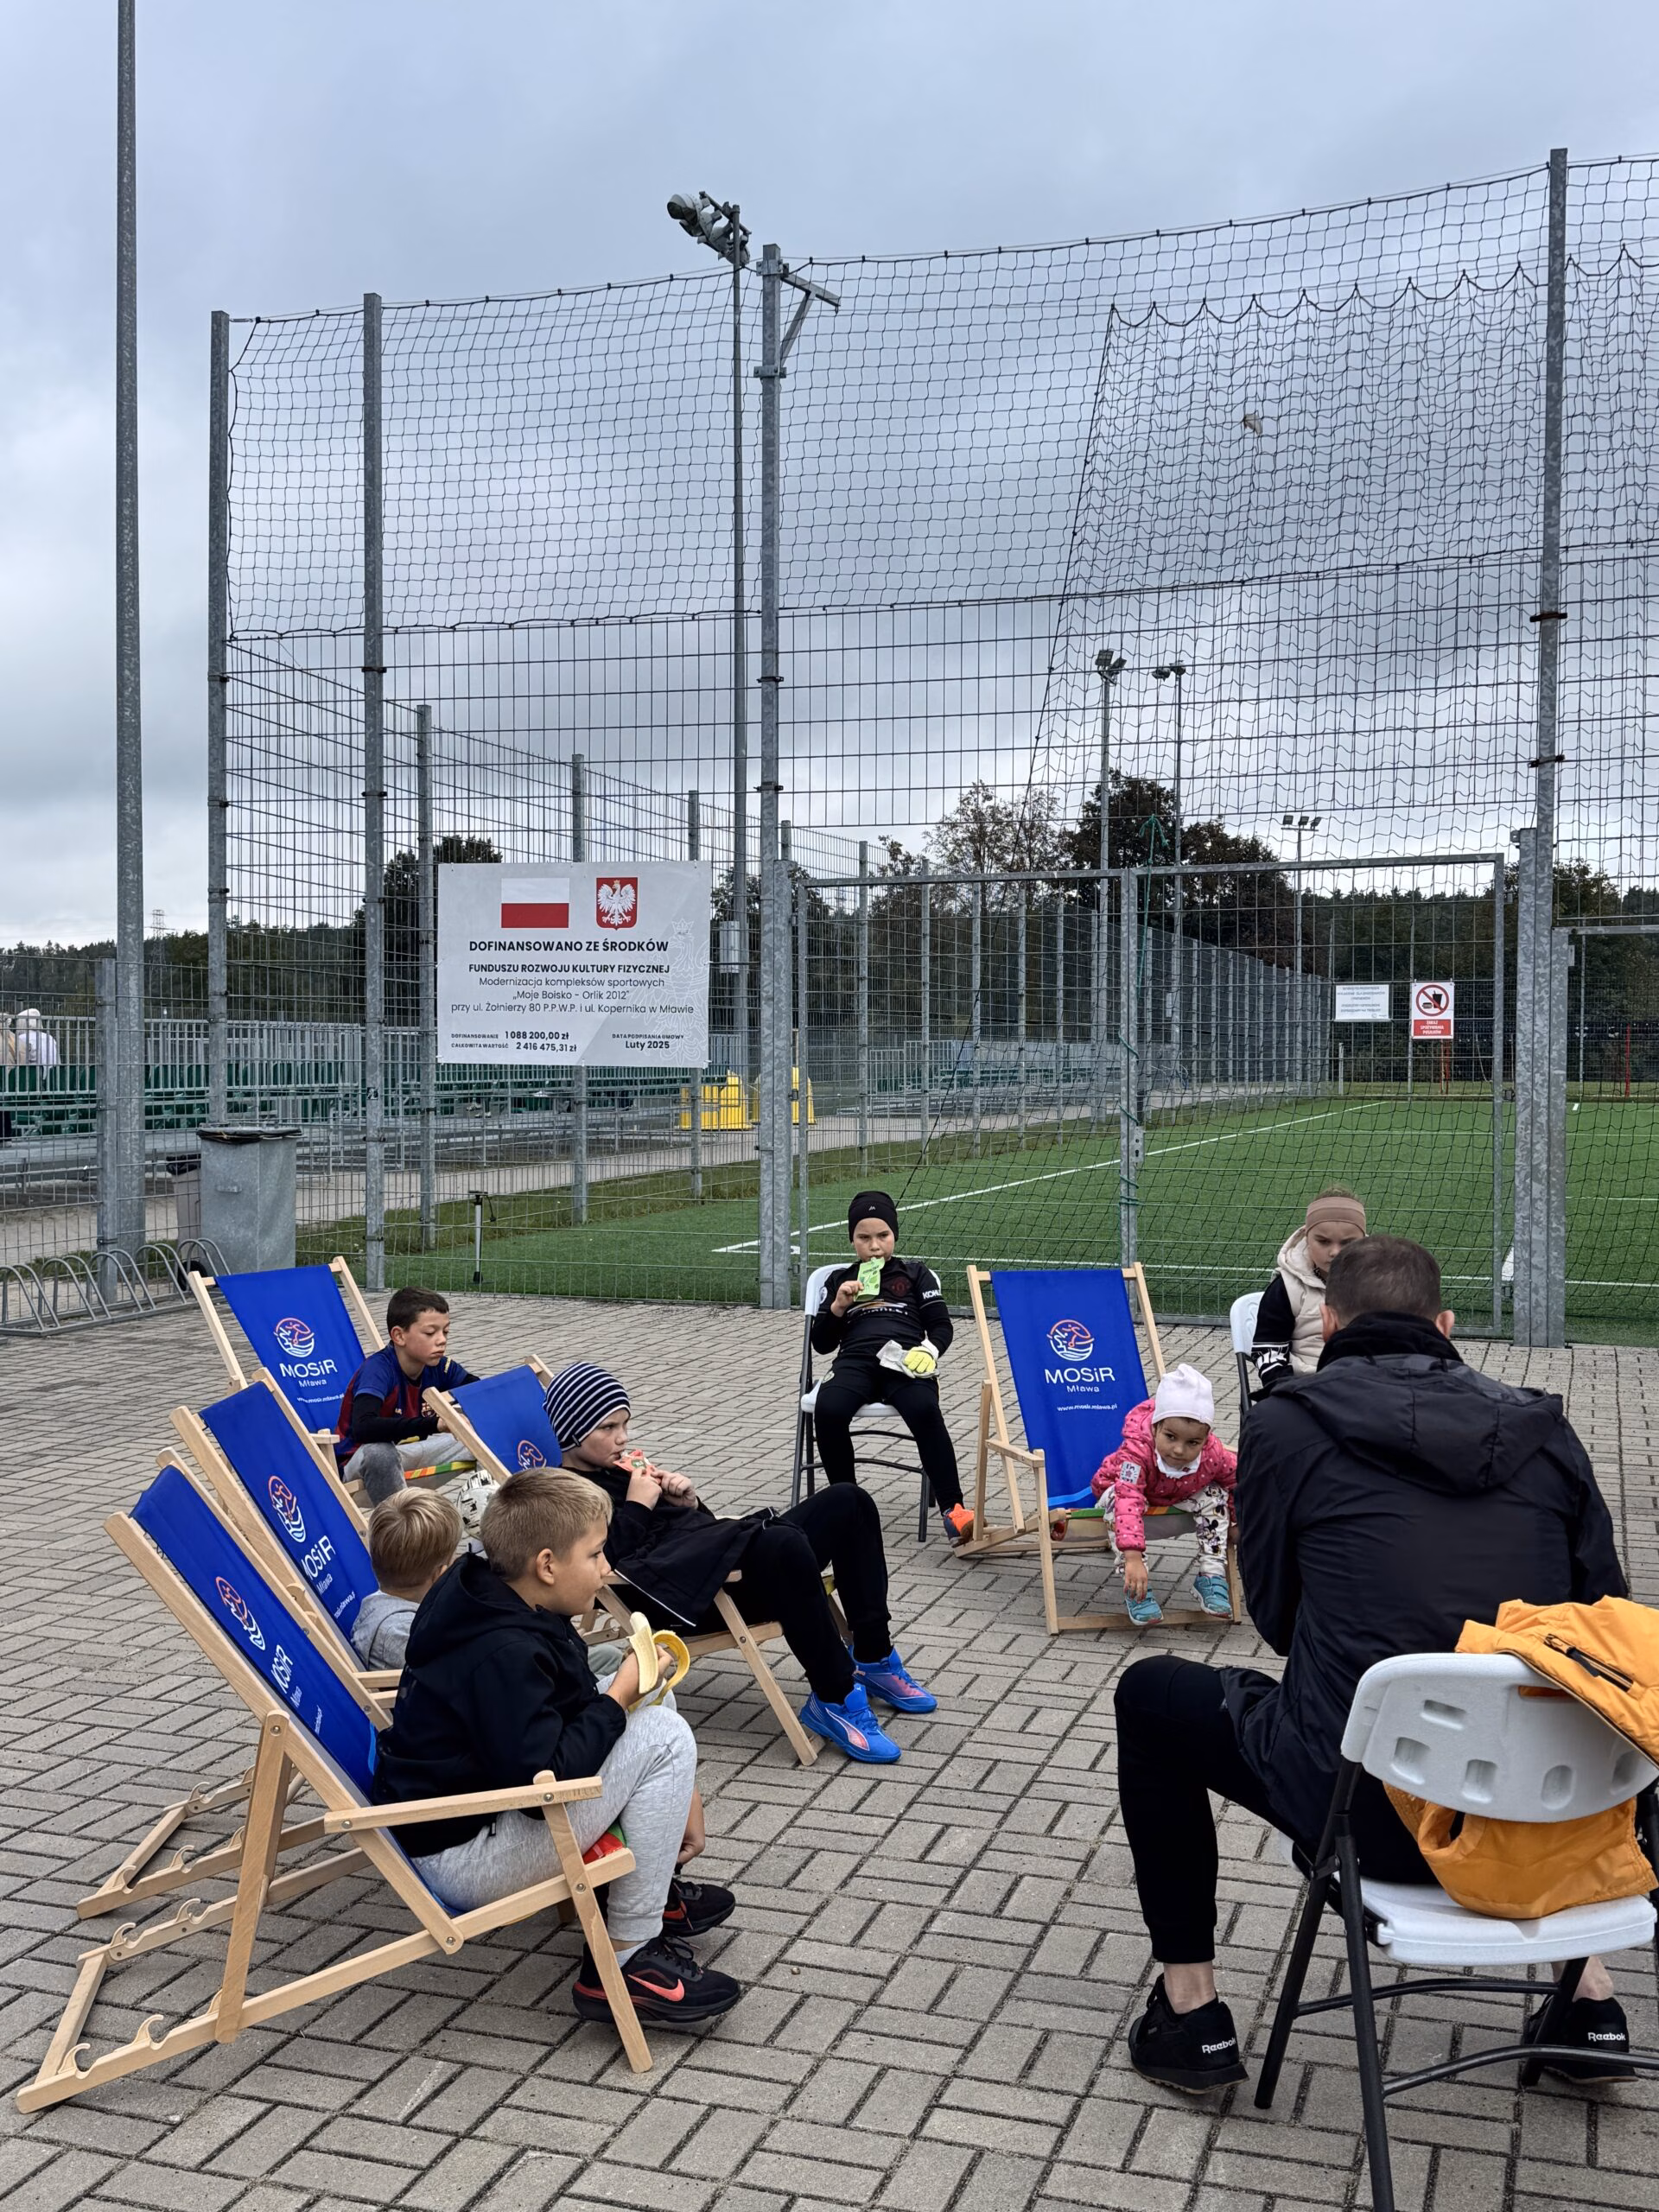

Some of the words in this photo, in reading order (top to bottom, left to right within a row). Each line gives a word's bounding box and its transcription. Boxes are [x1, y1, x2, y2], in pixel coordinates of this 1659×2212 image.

[469, 941, 583, 951] DOFINANSOWANO
[586, 941, 600, 951] ZE
[602, 938, 669, 951] ŚRODKÓW
[468, 963, 519, 973] FUNDUSZU
[521, 964, 570, 973] ROZWOJU
[572, 964, 615, 973] KULTURY
[617, 964, 670, 974] FIZYCZNEJ
[479, 977, 543, 988] Modernizacja
[545, 977, 605, 988] kompleksów
[607, 978, 665, 988] sportowych
[542, 990, 572, 1000] Boisko
[582, 990, 604, 1000] Orlik
[451, 1003, 471, 1014] przy
[473, 1003, 483, 1012] ul.
[486, 1001, 526, 1014] Żołnierzy
[529, 1003, 541, 1012] 80
[543, 1003, 577, 1013] P.P.W.P.
[585, 1004, 594, 1013] ul.
[598, 1004, 646, 1014] Kopernika
[659, 1004, 694, 1014] Mławie
[529, 1032, 560, 1040] 200,00
[539, 1043, 568, 1052] 475,31
[625, 1040, 645, 1051] Luty
[647, 1040, 670, 1049] 2025
[279, 1359, 338, 1378] MOSiR
[1045, 1367, 1116, 1383] MOSiR
[298, 1379, 327, 1388] Mława
[1587, 2031, 1626, 2042] Reebok
[1201, 2037, 1236, 2054] Reebok
